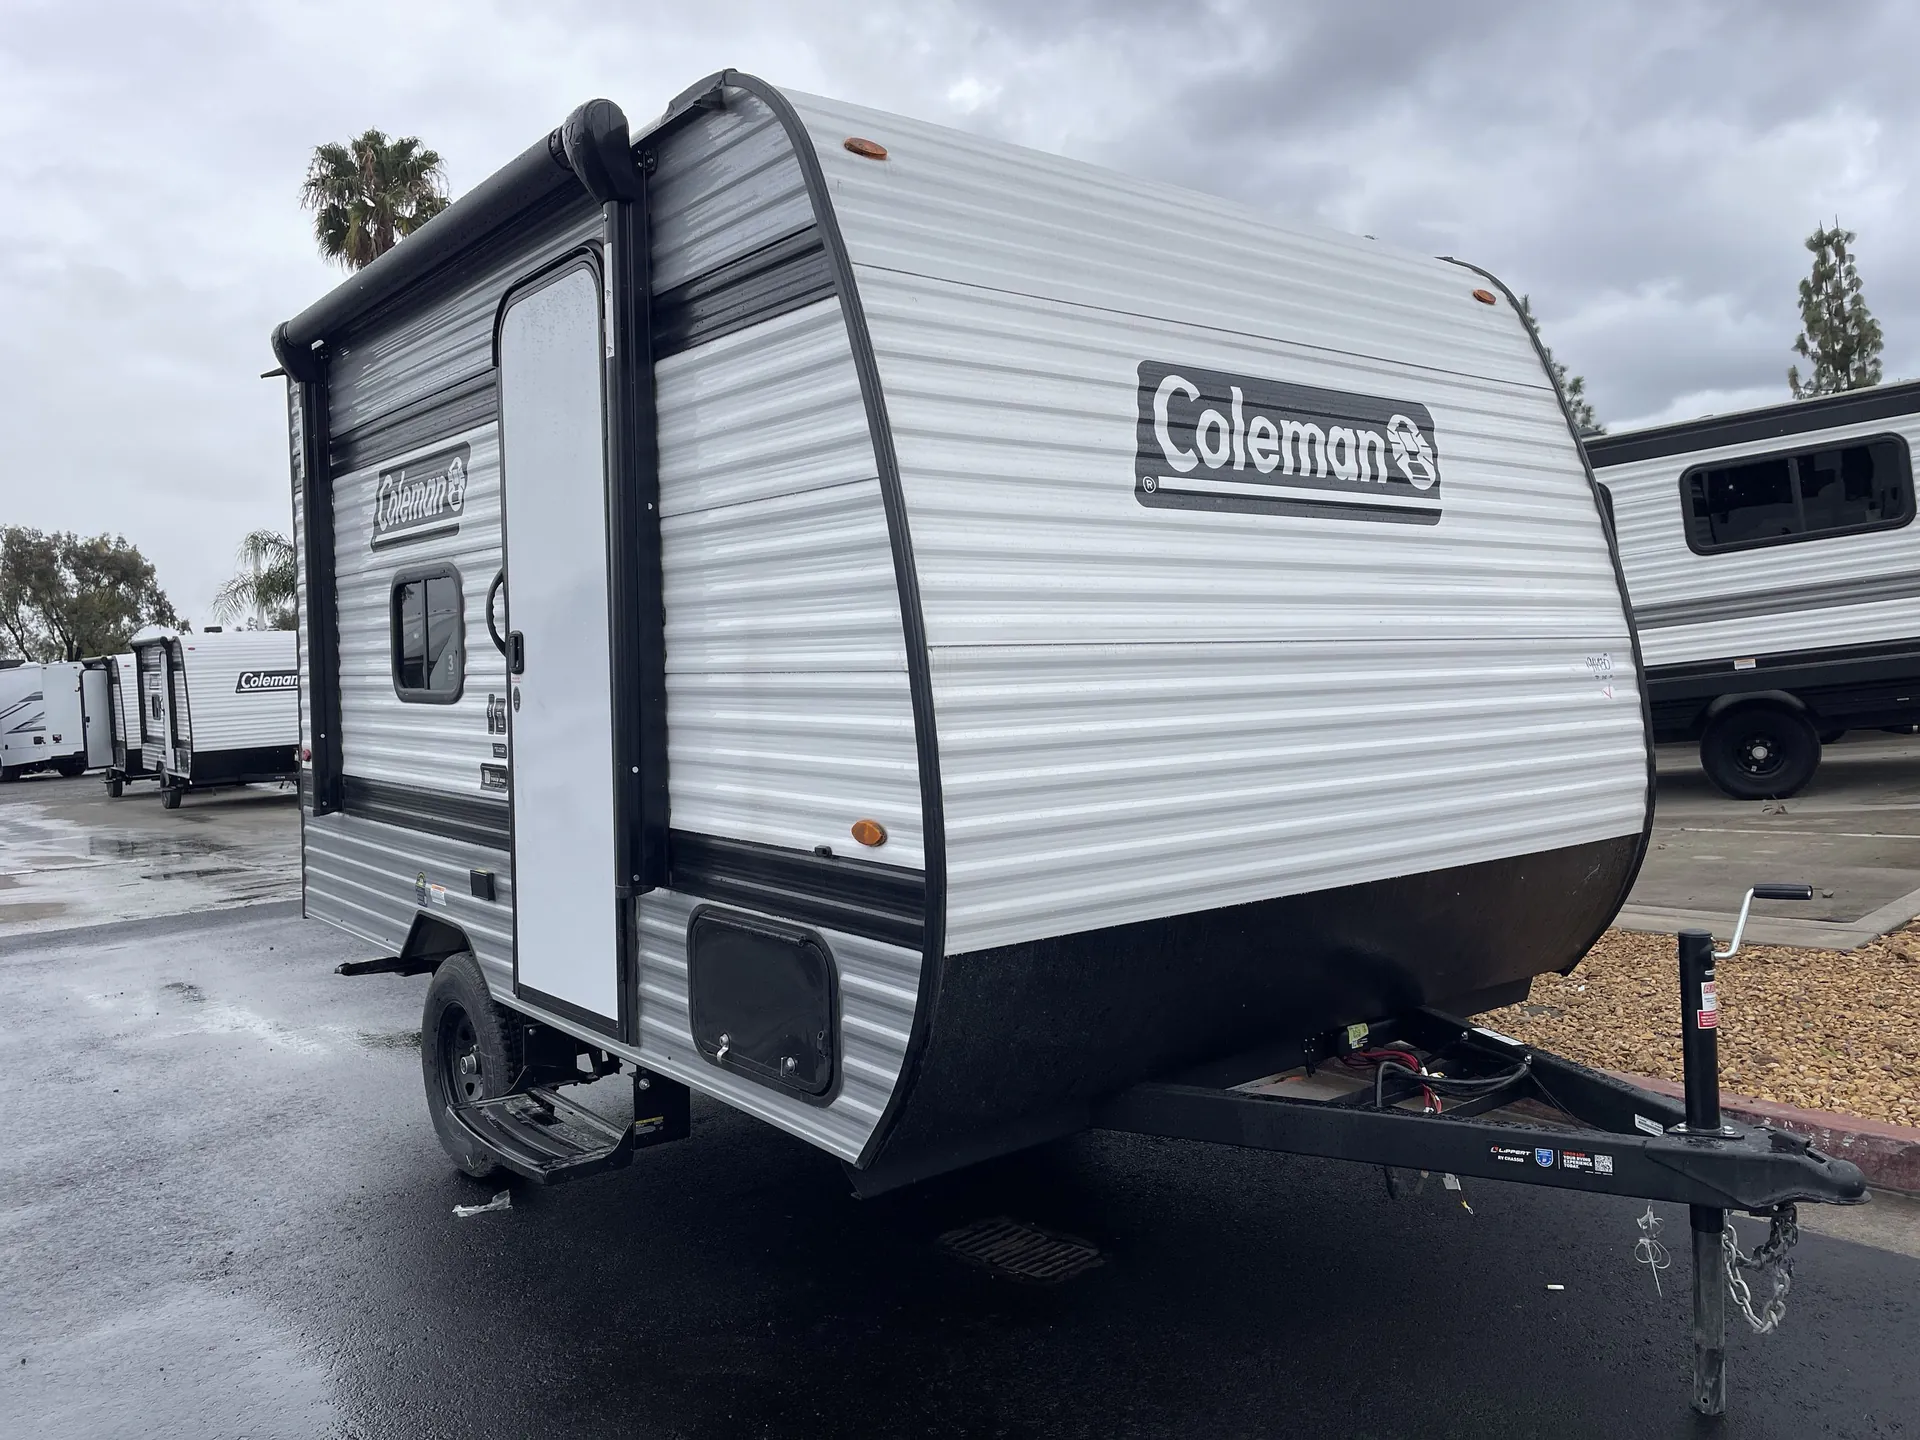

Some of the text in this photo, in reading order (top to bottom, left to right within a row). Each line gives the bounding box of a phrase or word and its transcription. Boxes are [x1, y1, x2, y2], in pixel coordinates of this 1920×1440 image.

[1153, 374, 1388, 484] Coleman
[378, 471, 446, 531] Coleman
[241, 672, 298, 688] Coleman
